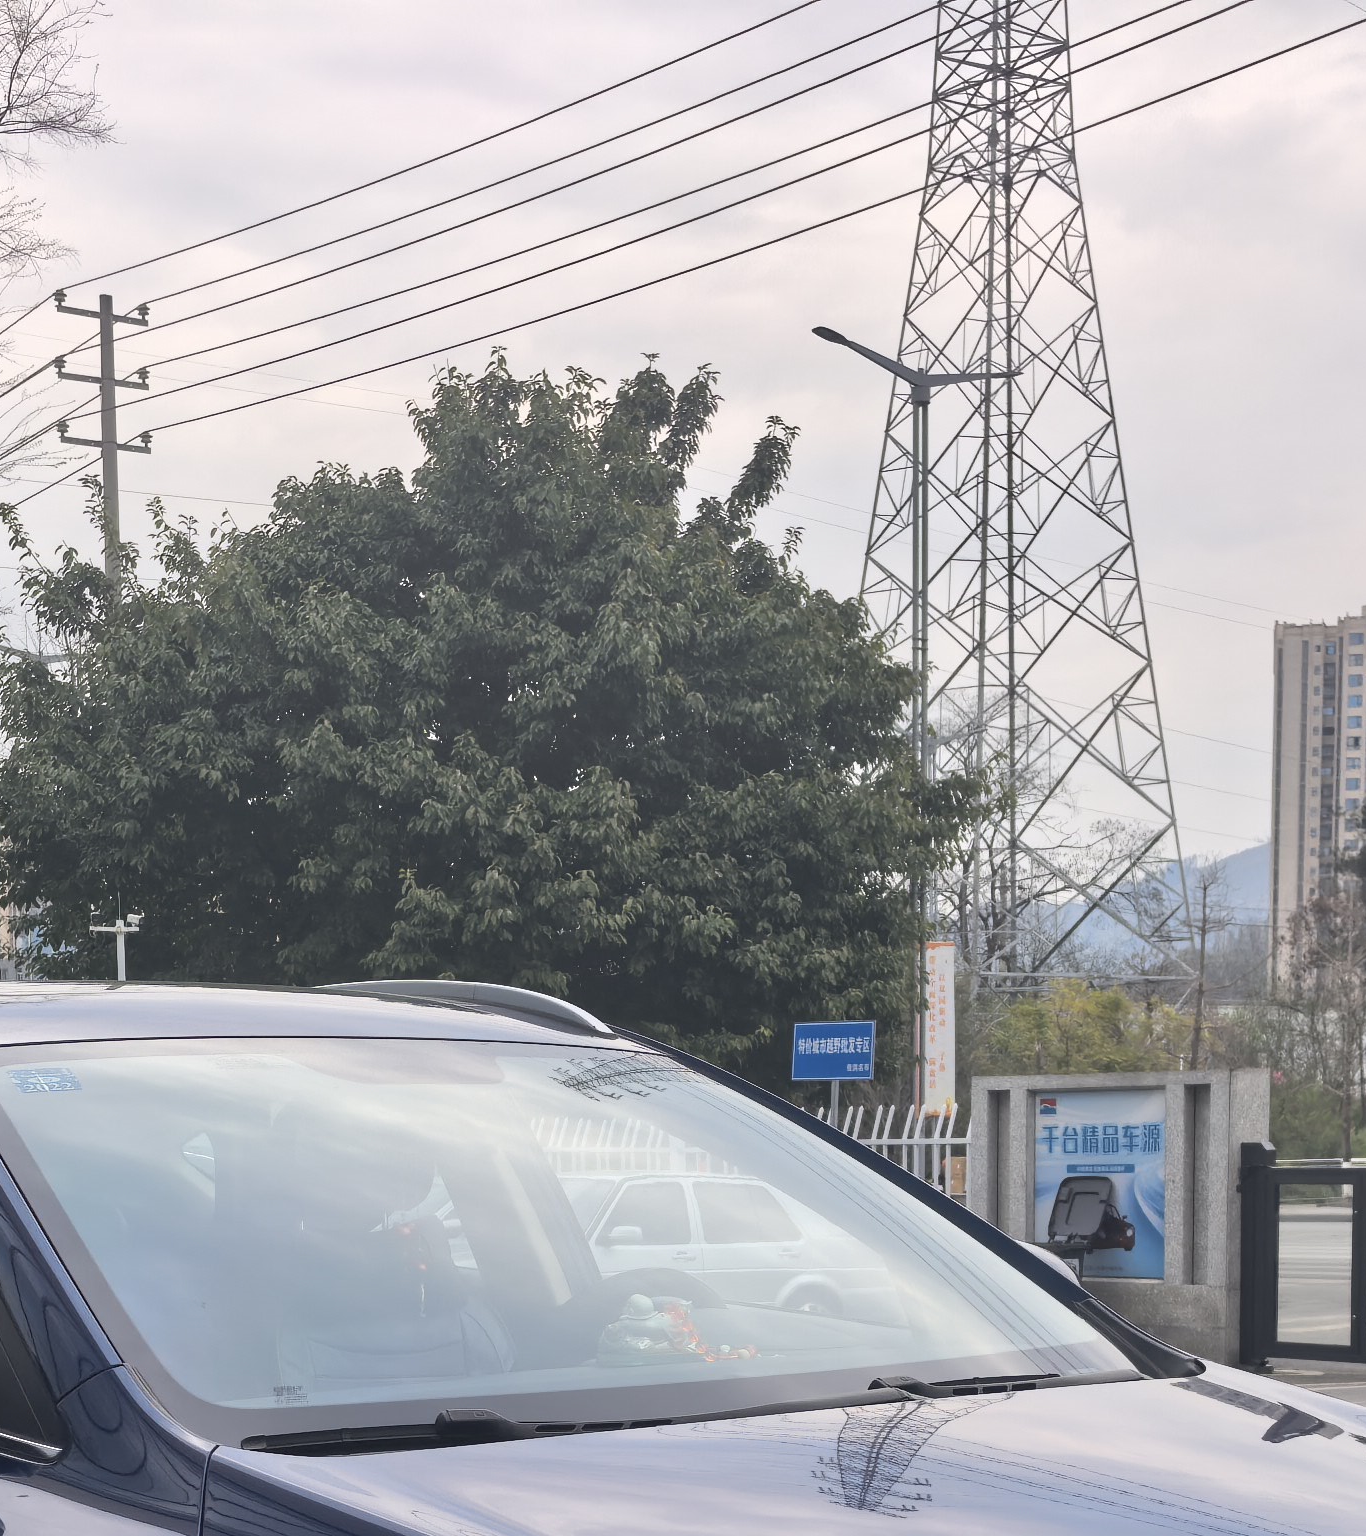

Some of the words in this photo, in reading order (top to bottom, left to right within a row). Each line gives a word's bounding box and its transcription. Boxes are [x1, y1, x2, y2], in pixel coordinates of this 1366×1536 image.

[798, 1036, 871, 1055] 特价城市越野批发专区
[23, 1082, 75, 1093] 2022
[1042, 1124, 1162, 1154] 千台精品车源
